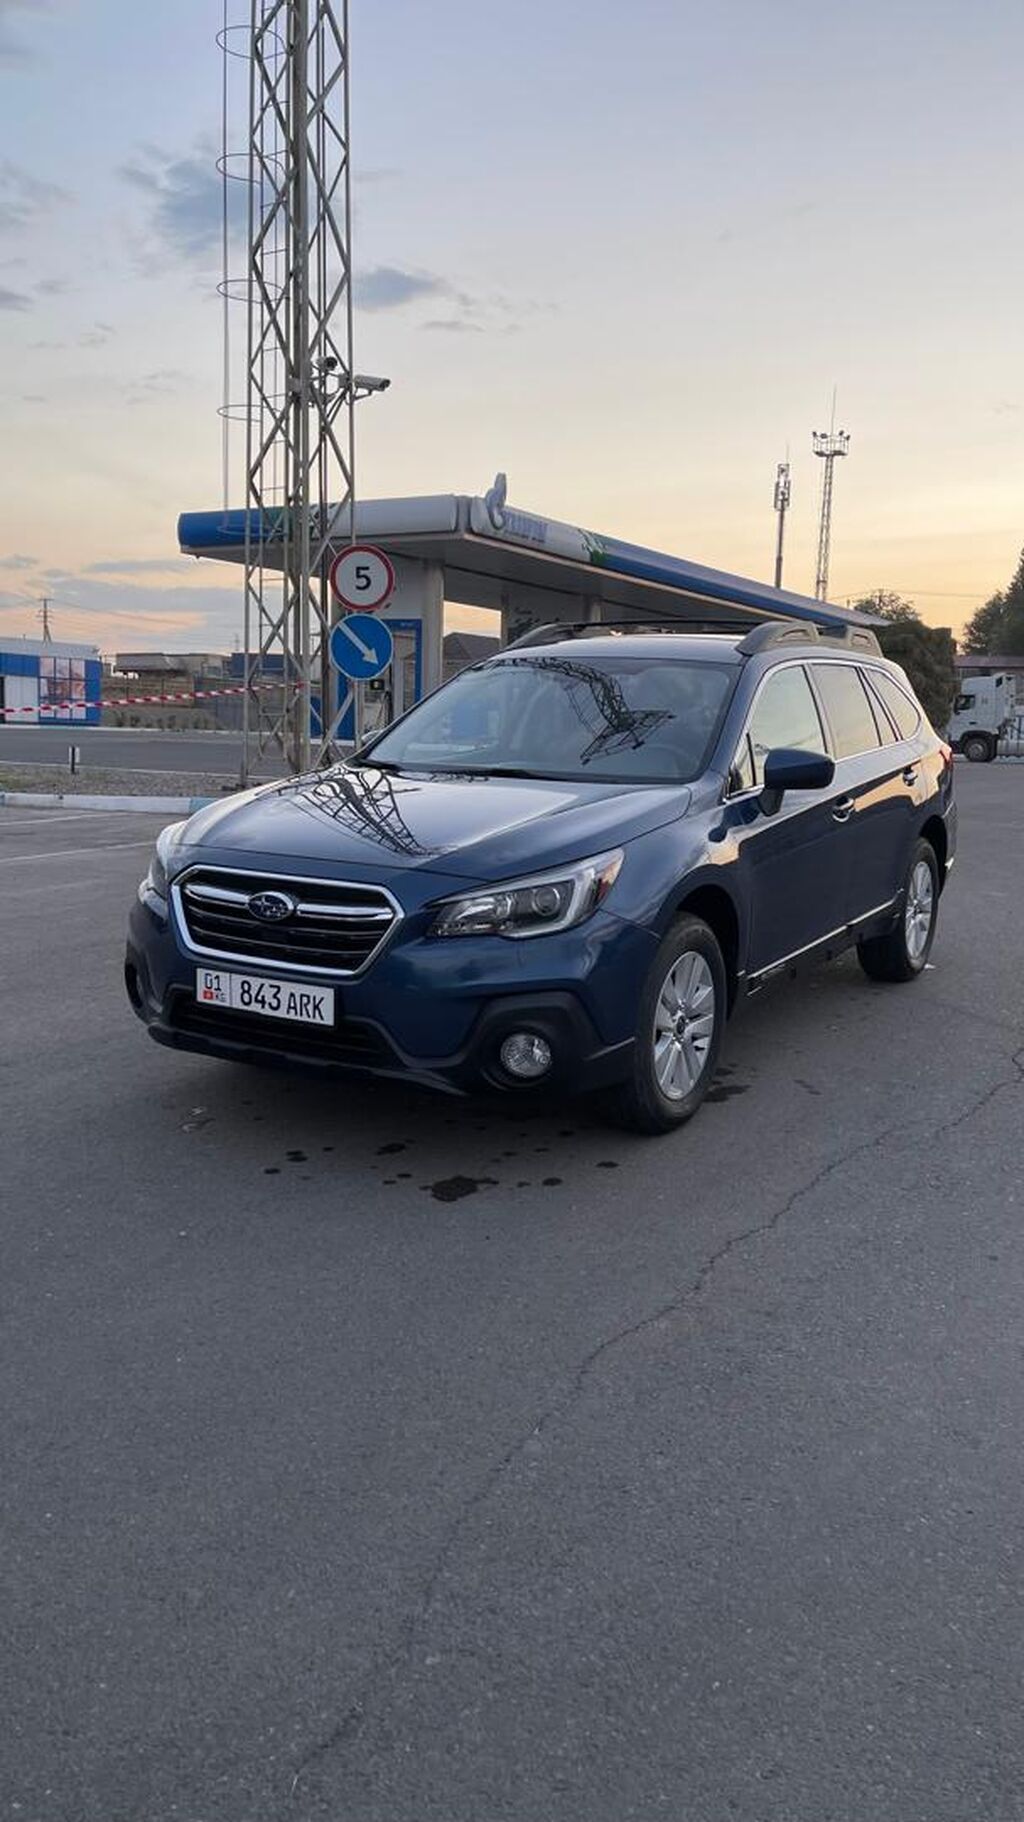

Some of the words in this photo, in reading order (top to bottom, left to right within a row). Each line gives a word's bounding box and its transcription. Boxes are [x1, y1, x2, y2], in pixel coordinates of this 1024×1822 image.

[355, 566, 372, 590] 5
[204, 973, 222, 991] 01
[240, 980, 281, 1011] 843
[286, 992, 325, 1020] ARK
